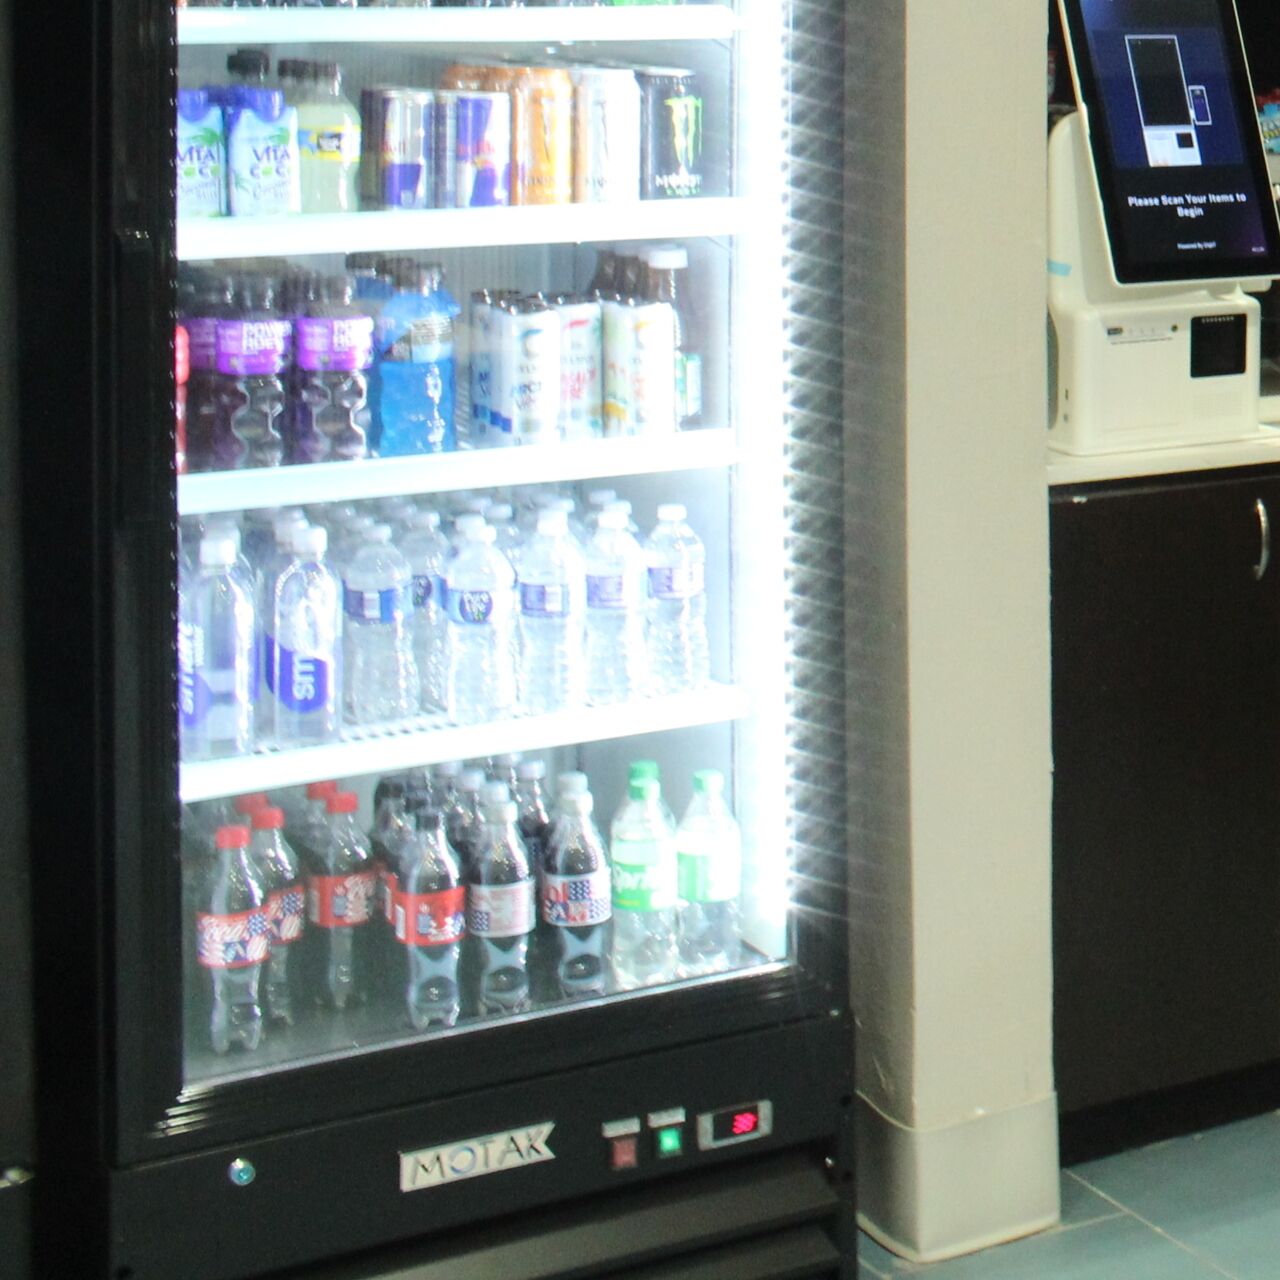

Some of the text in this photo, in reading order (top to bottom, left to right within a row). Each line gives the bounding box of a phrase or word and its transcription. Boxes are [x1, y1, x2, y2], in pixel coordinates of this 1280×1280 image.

[1127, 192, 1247, 207] Please Scan Your Items to
[1176, 206, 1204, 218] Begin
[412, 1128, 544, 1186] MOTAK
